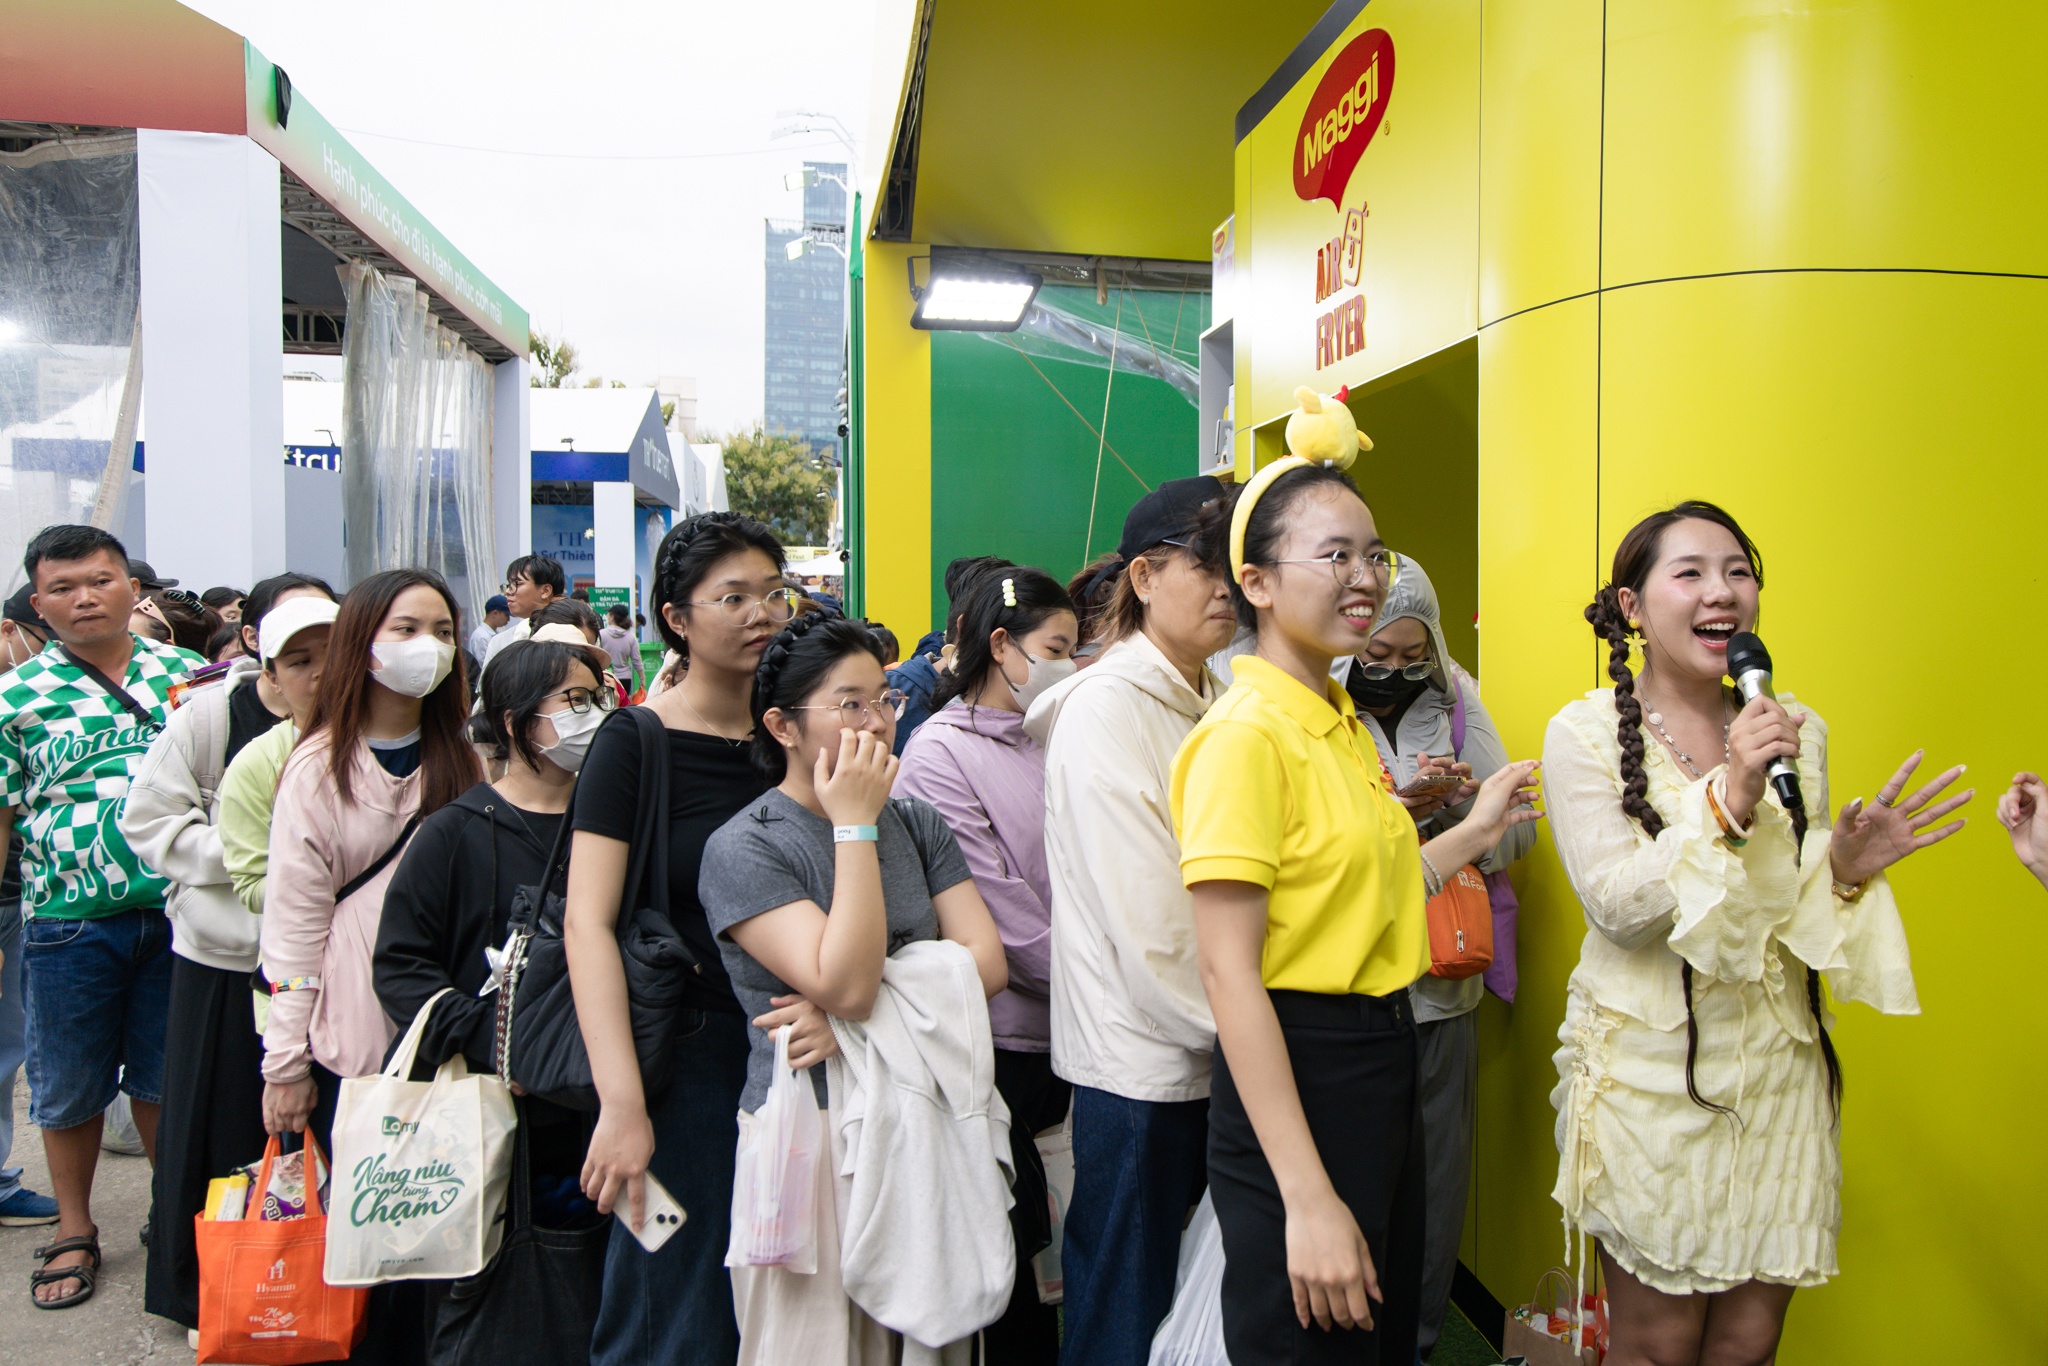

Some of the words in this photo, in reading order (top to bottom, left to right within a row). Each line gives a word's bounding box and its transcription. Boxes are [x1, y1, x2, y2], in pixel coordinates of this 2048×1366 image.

[1304, 50, 1378, 177] Maggi
[322, 141, 357, 200] Hạnh
[360, 182, 389, 228] phúc
[392, 210, 410, 246] cho
[411, 227, 421, 257] đi
[421, 234, 430, 265] là
[432, 243, 454, 286] hạnh
[455, 269, 474, 303] phúc
[475, 286, 490, 314] còn
[1316, 237, 1342, 304] AIR
[1316, 294, 1366, 371] FRYER
[553, 531, 582, 547] TH
[560, 550, 594, 561] Thiên
[353, 1153, 411, 1195] Nâng
[414, 1159, 455, 1182] niu
[350, 1186, 446, 1228] Chạm
